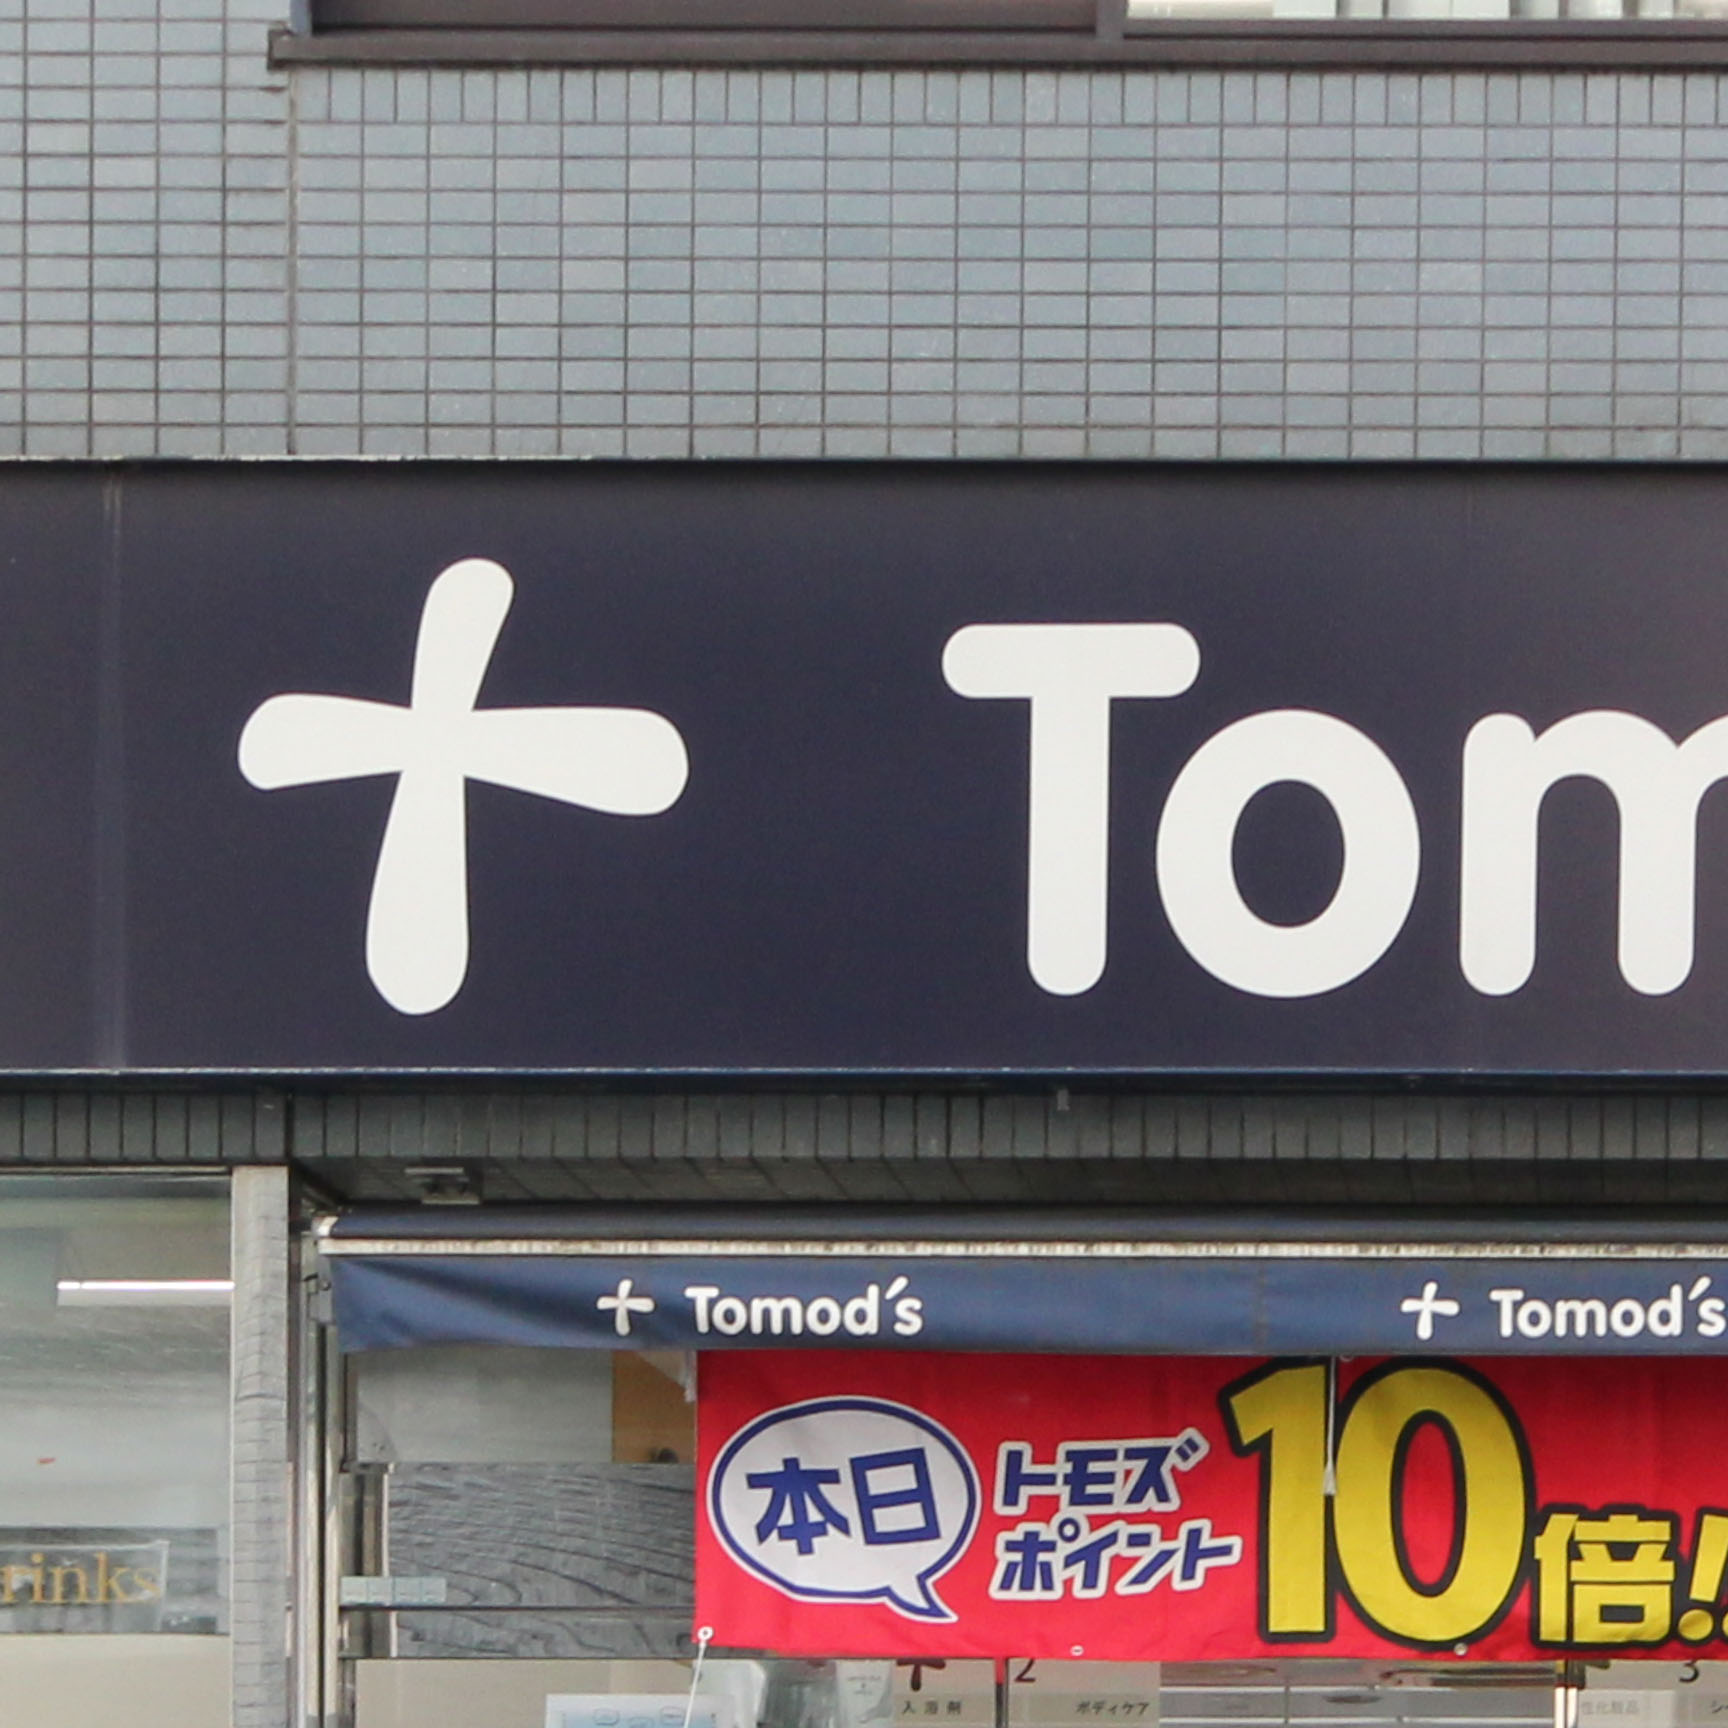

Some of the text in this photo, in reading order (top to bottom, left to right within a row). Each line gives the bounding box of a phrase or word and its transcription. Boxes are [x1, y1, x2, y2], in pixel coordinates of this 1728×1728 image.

[685, 1277, 925, 1338] Tomod's
[1489, 1277, 1727, 1339] Tomod's
[746, 1447, 942, 1556] 本日
[1000, 1430, 1202, 1512] トモズ
[997, 1519, 1240, 1595] ポイント
